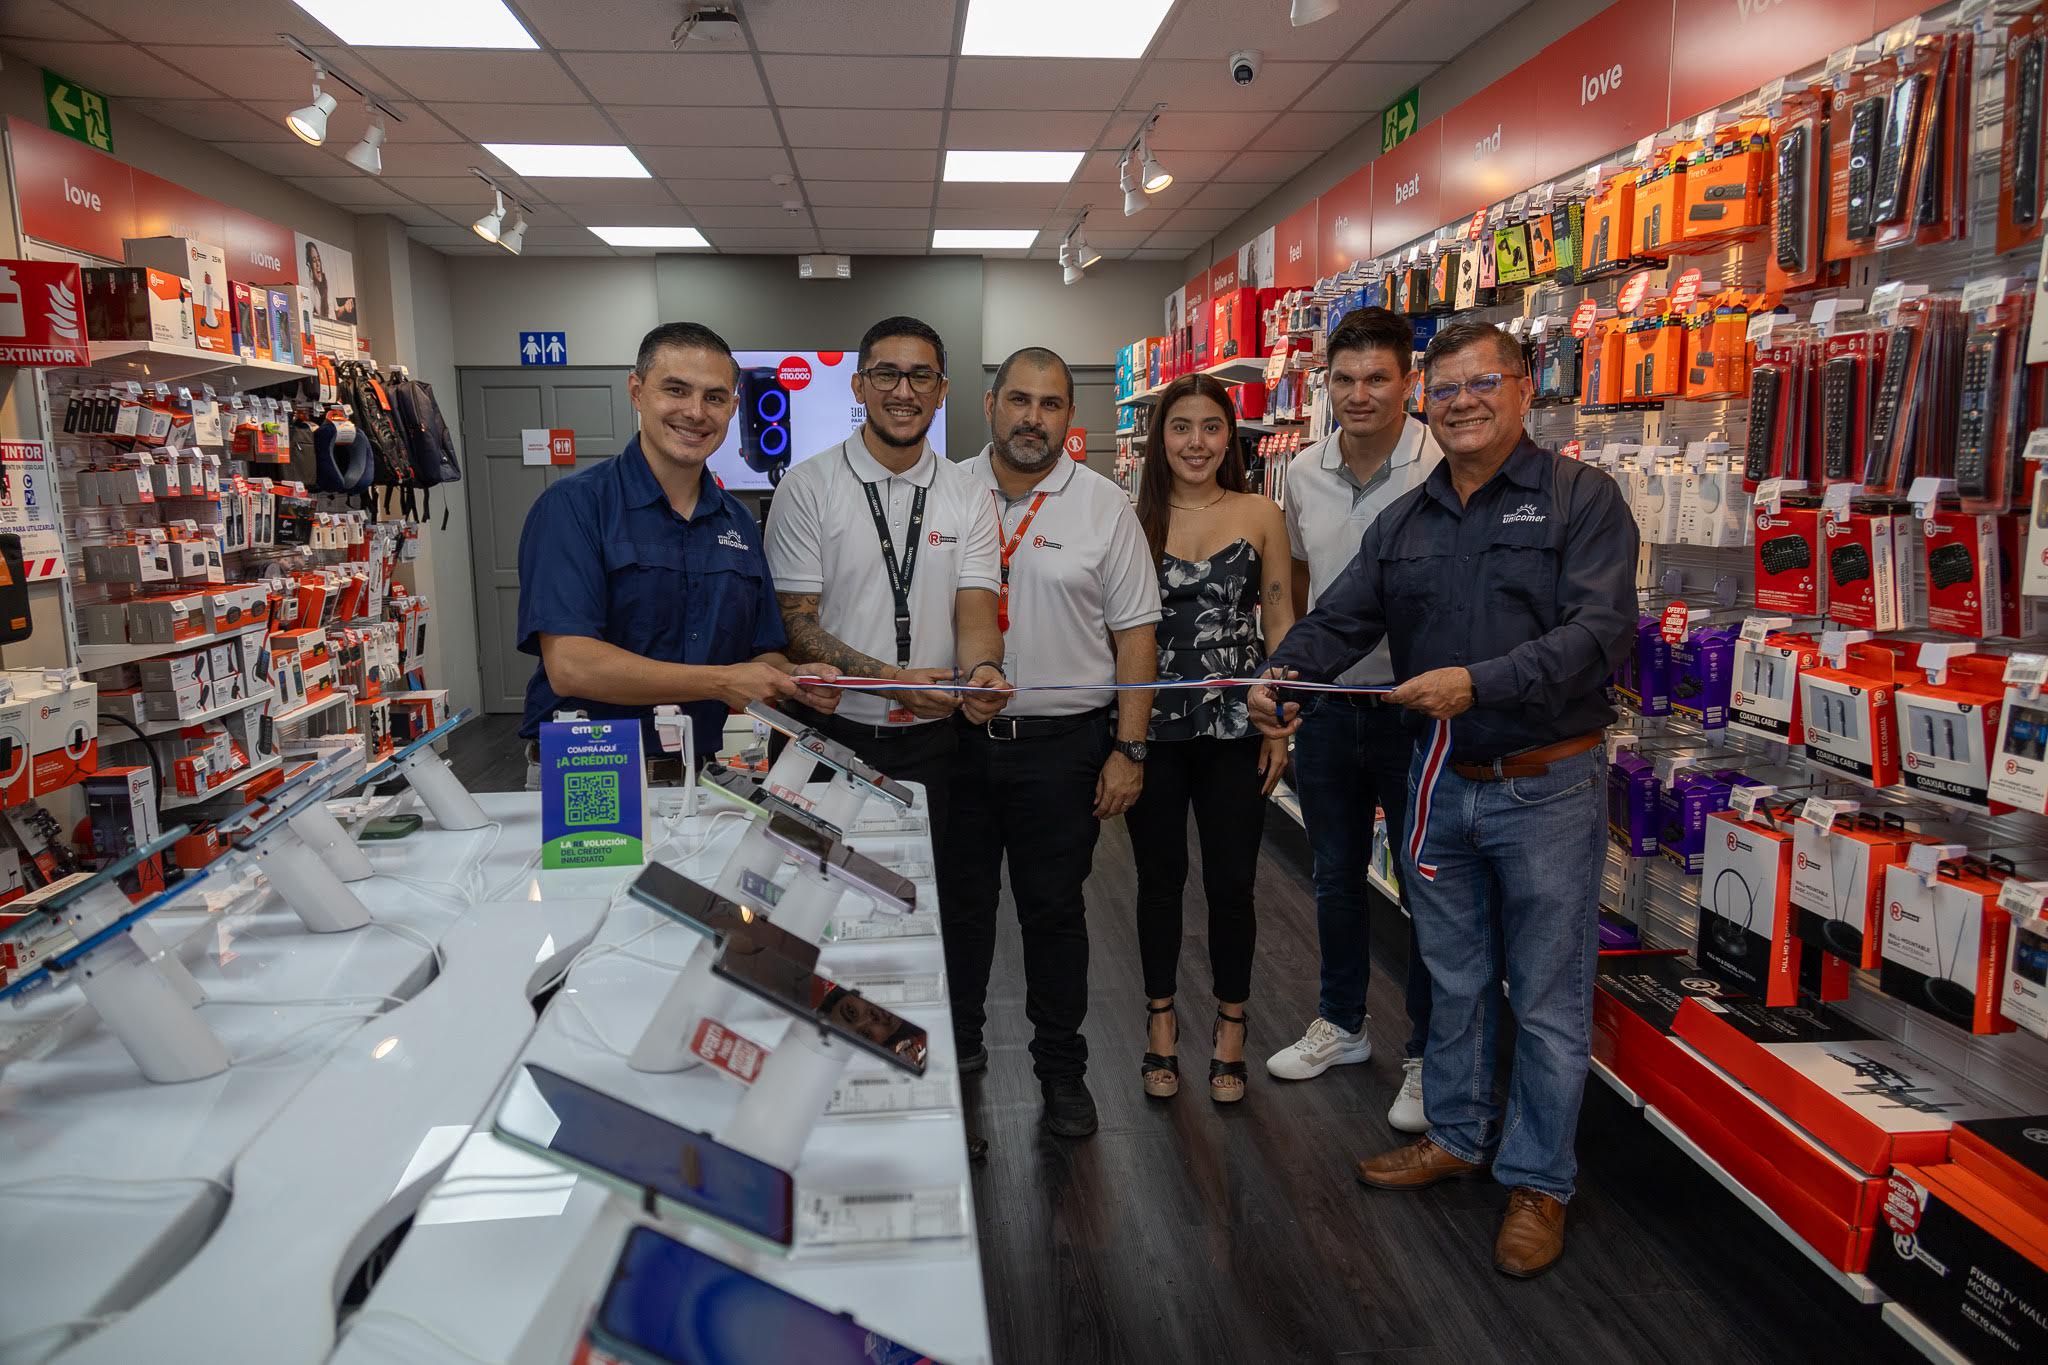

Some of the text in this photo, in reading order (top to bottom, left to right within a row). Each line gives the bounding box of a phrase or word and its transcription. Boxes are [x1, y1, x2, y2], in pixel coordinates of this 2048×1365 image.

[1581, 63, 1622, 106] love
[1864, 84, 1886, 97] SONY
[1474, 124, 1501, 161] and
[64, 178, 101, 212] love
[1396, 173, 1420, 205] beat
[1335, 216, 1349, 237] the
[250, 250, 281, 272] home
[1289, 240, 1302, 263] feel
[1214, 272, 1234, 292] follow us
[572, 724, 612, 737] emma
[1739, 712, 1778, 728] COAXIAL CABLE
[567, 744, 616, 754] COMPRÁ AQUÍ
[572, 754, 628, 766] CRÉDITO!
[1816, 750, 1858, 770] COAXIAL CABLE
[1917, 776, 1946, 790] COAXIAL
[1947, 784, 1971, 796] CABLE
[560, 841, 571, 849] LA
[577, 846, 612, 855] CRÉDITO
[1888, 1177, 1917, 1200] OFERTA
[1967, 1278, 2004, 1310] MOUNT
[1970, 1266, 2000, 1292] FIXED
[2002, 1288, 2017, 1304] TV
[2018, 1300, 2048, 1330] WALL
[1962, 1303, 1979, 1318] EASY
[1980, 1316, 1989, 1327] TO
[1990, 1324, 2020, 1351] INSTALL!
